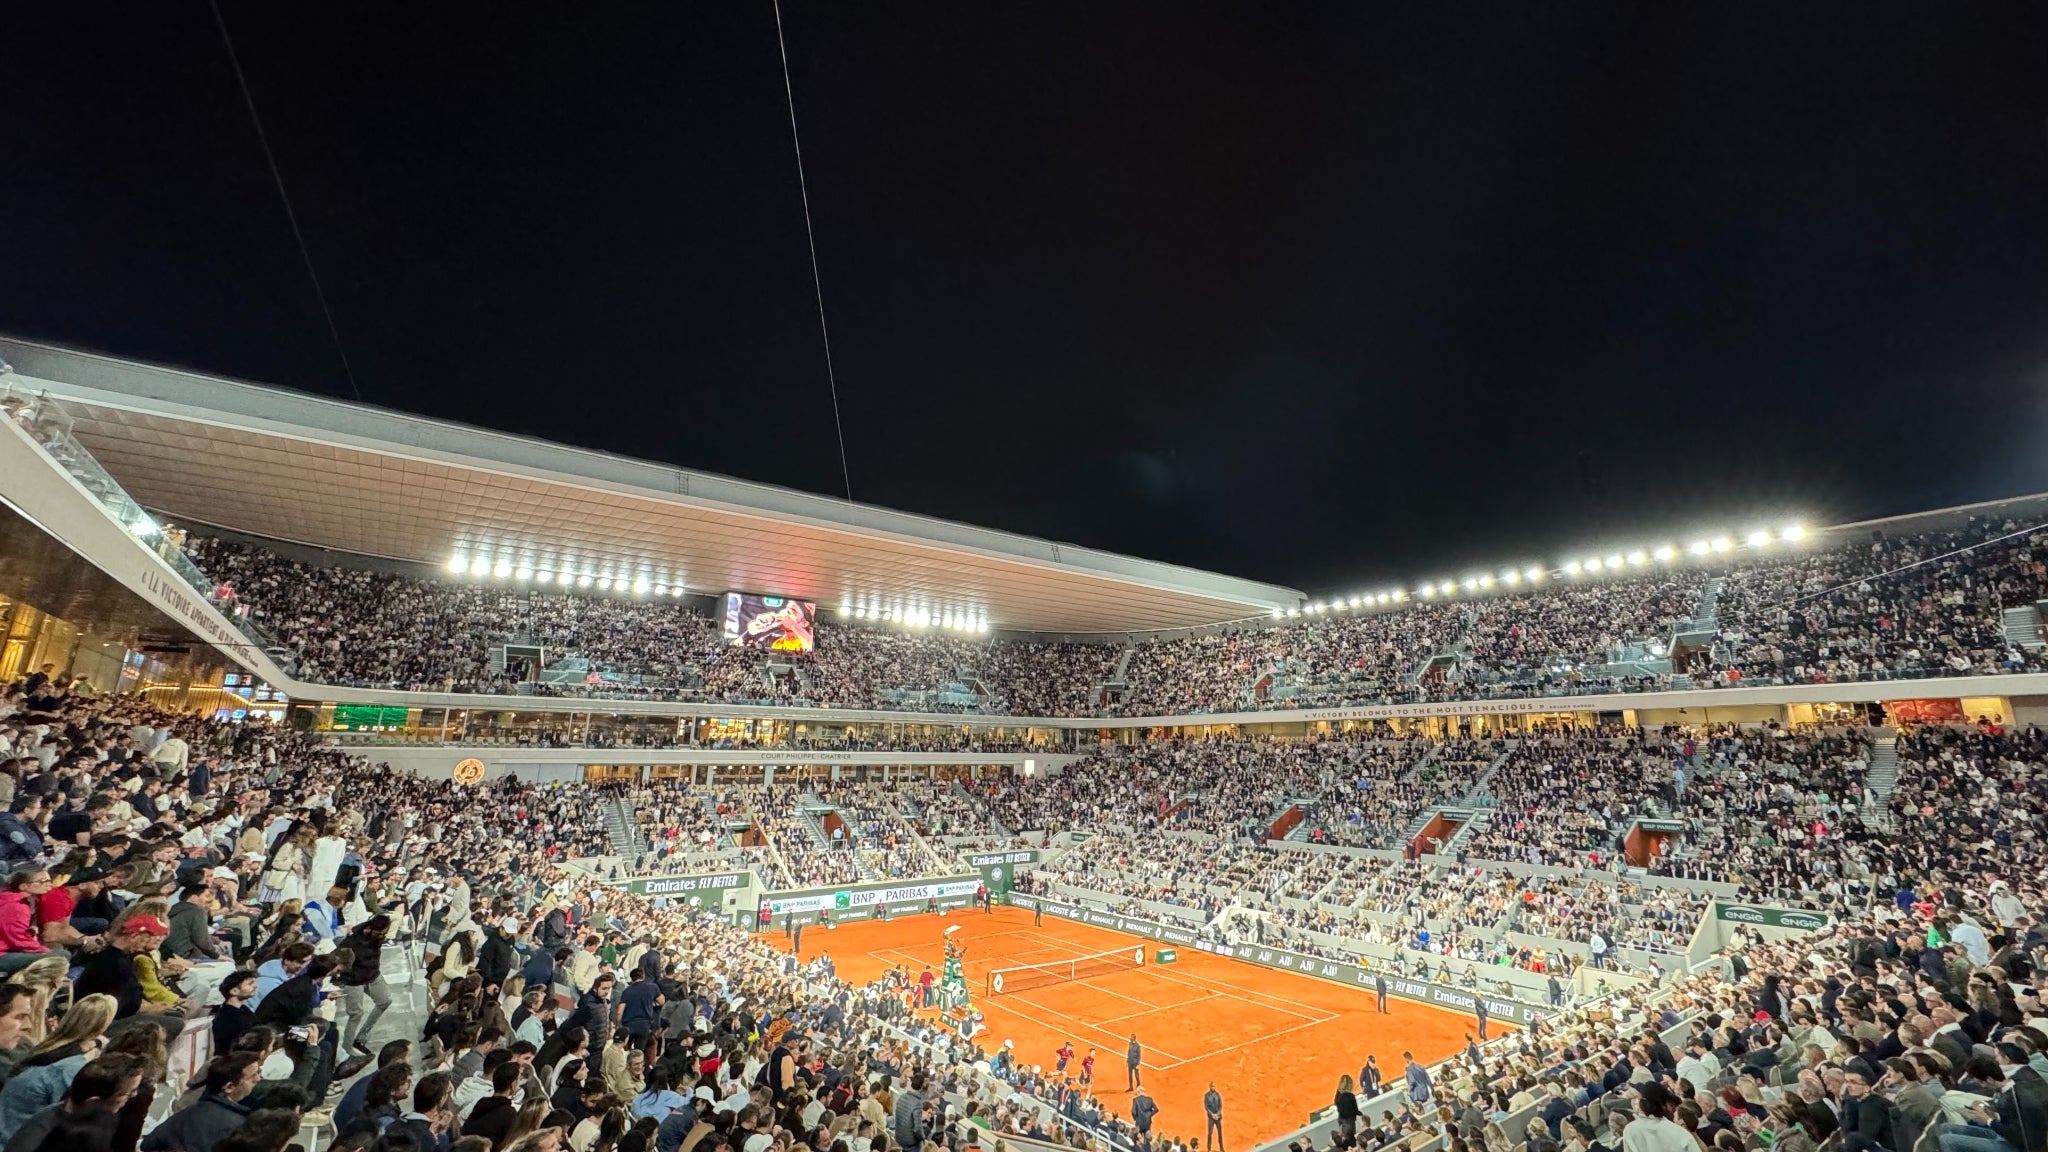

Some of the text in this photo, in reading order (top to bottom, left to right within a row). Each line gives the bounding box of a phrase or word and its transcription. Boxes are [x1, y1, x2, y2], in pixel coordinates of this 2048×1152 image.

[161, 582, 192, 616] VICTOIRE
[1312, 711, 1348, 719] VICTORY
[1468, 703, 1533, 712] TENACIOUS
[786, 752, 816, 760] PHILIPPE
[973, 855, 1004, 866] Emirates
[646, 874, 738, 893] Emirates FLY BETTER
[853, 887, 928, 905] BNP PARIBAS
[796, 899, 820, 907] PARIBAS
[1012, 897, 1033, 908] LACOSTE
[1046, 904, 1070, 916] LACOSTE
[1090, 914, 1115, 925] RENAULT
[1125, 922, 1153, 934] RENAULT
[1164, 931, 1194, 943] RENAULT
[1395, 980, 1406, 992] FLY
[1405, 984, 1427, 997] BETTER
[1434, 989, 1475, 1009] Emirates
[1489, 1002, 1515, 1018] BETTER
